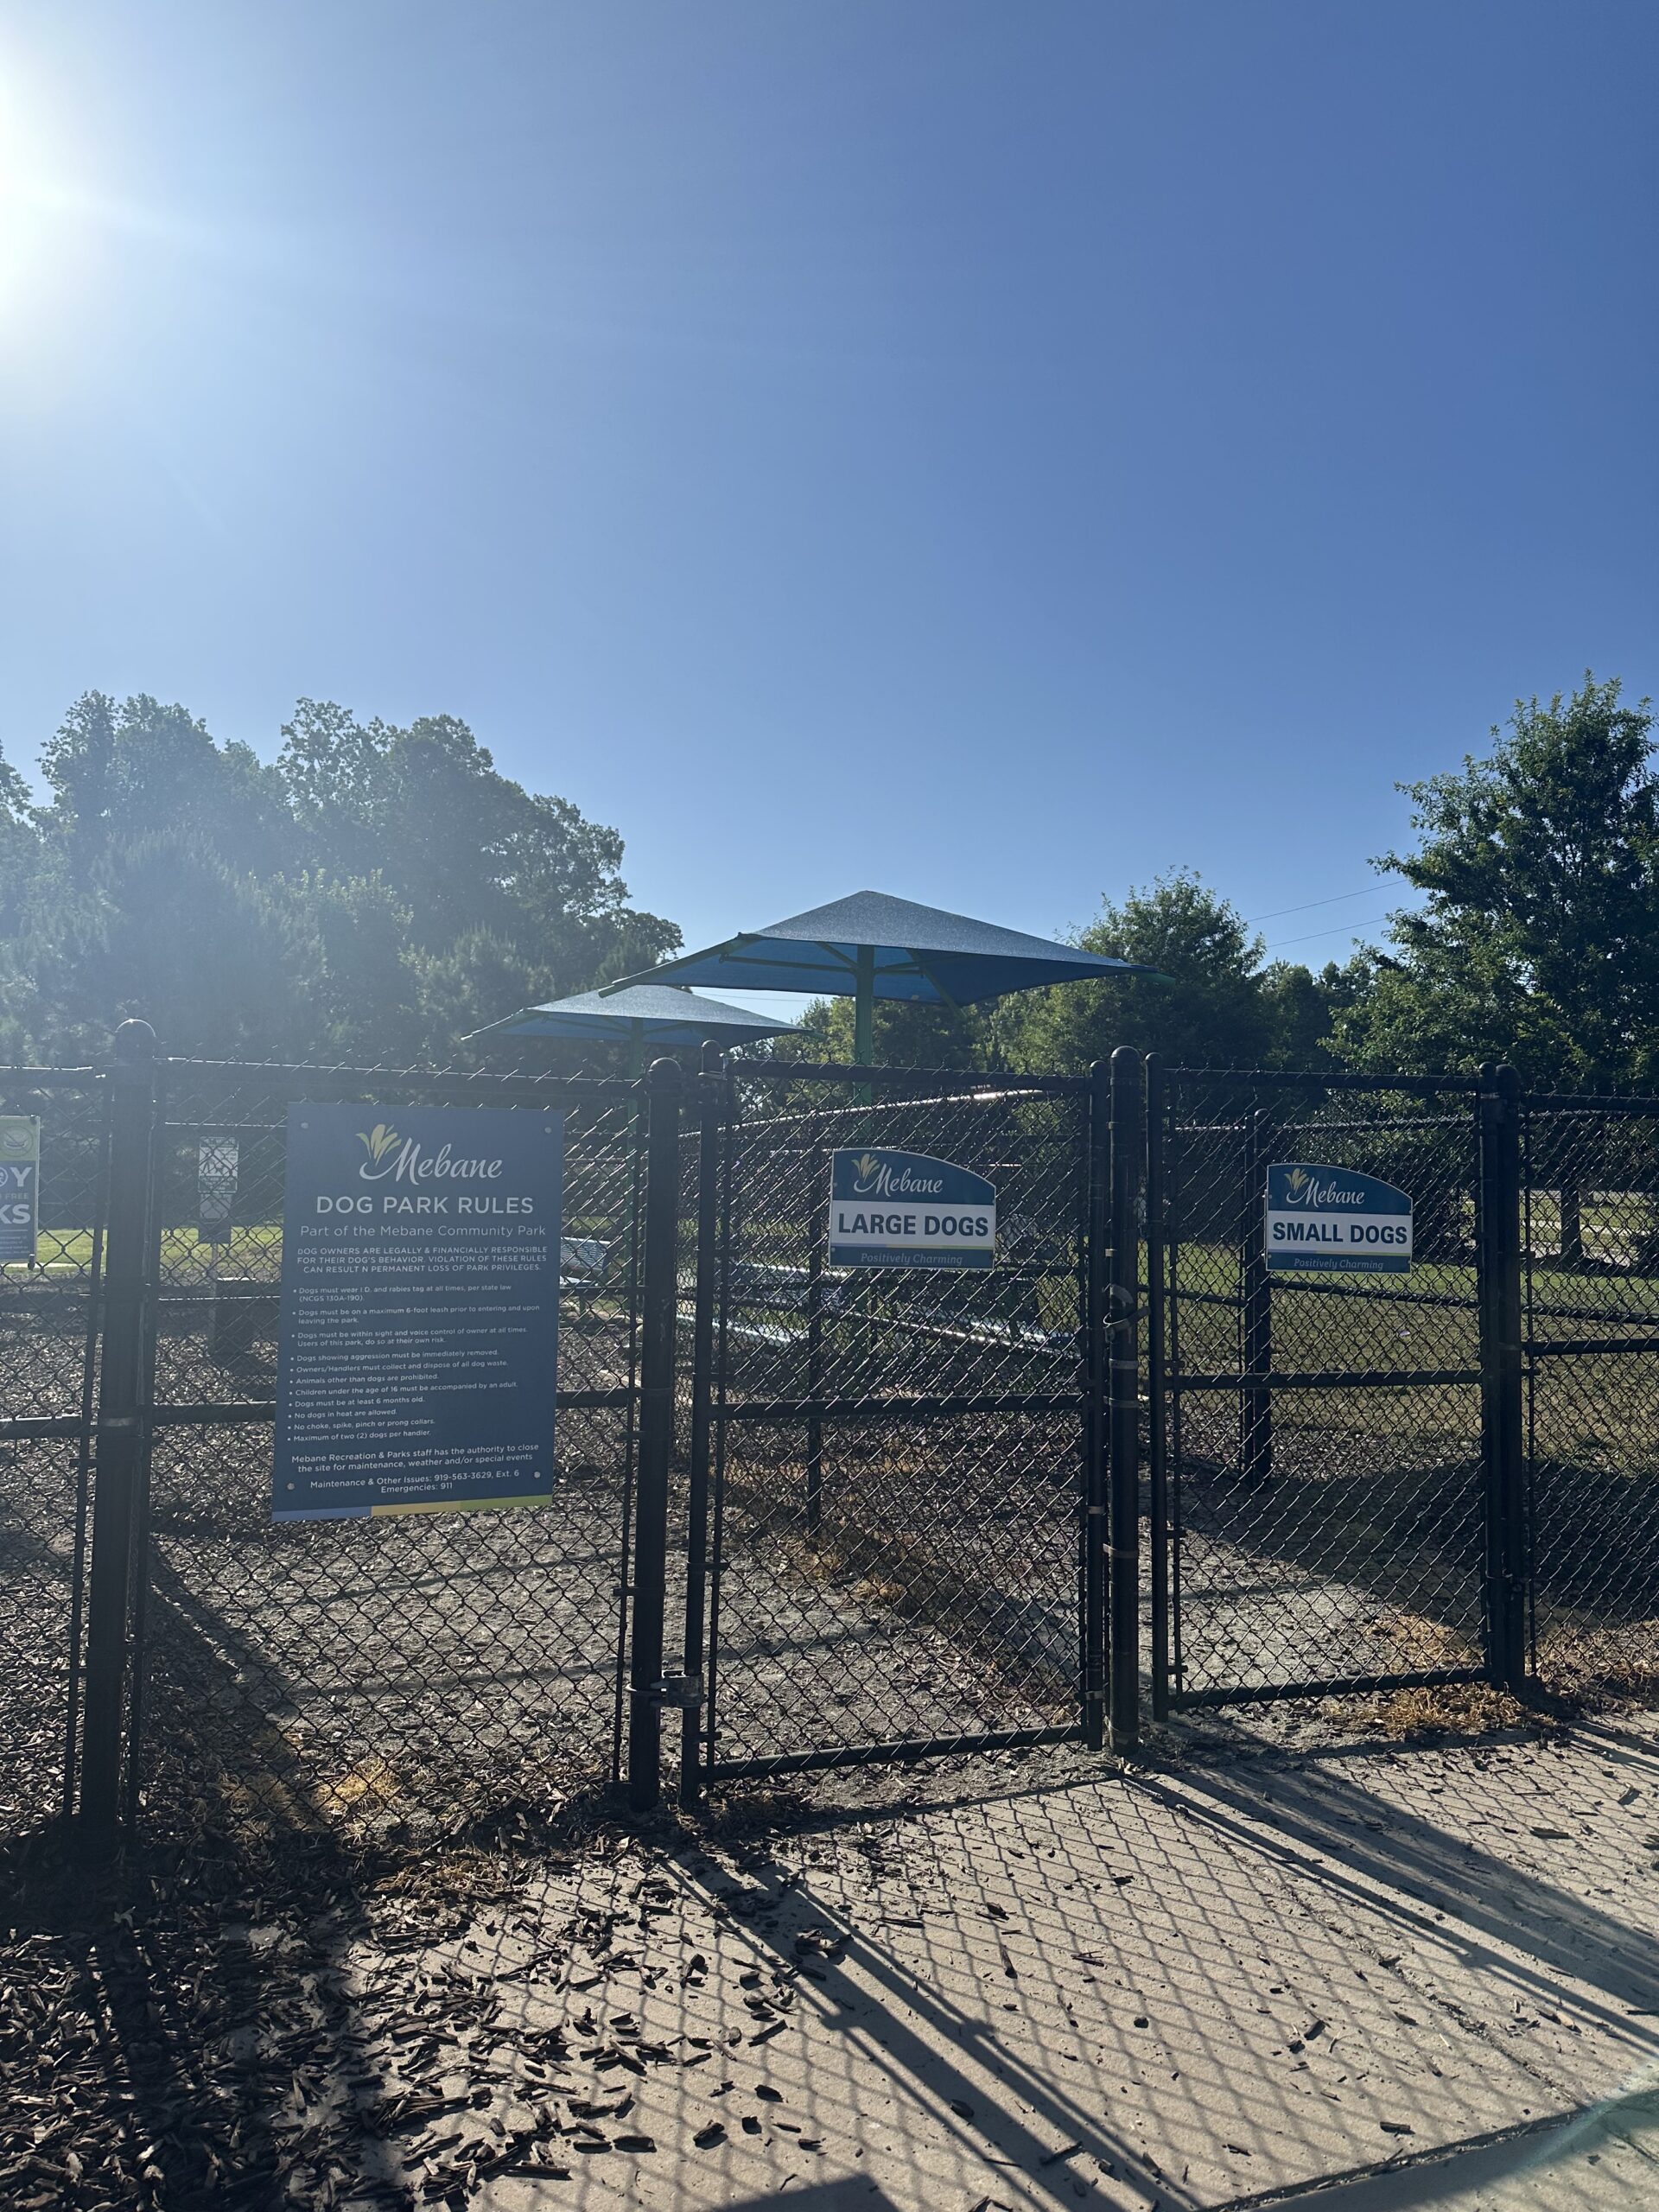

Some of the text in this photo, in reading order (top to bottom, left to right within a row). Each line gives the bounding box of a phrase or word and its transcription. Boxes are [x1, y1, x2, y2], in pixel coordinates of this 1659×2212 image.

[359, 1137, 503, 1185] Mebane
[853, 1163, 944, 1198] Mebane
[1286, 1177, 1365, 1208] Mebane
[316, 1196, 533, 1214] DOG PARK RULES
[301, 1224, 546, 1238] Part of the Mebane Community Park
[838, 1213, 988, 1236] LARGE DOGS
[1273, 1222, 1408, 1244] SMALL DOGS
[861, 1253, 963, 1266] Positively Charming
[1294, 1258, 1385, 1270] Positively Charming
[326, 1265, 359, 1274] RESULT
[296, 1364, 360, 1373] Owners/Handlers
[429, 1382, 477, 1391] accompanied
[478, 1382, 487, 1390] by
[355, 1421, 376, 1429] pinch
[291, 1454, 327, 1463] Mebane
[328, 1452, 376, 1461] Recreation
[378, 1451, 385, 1459] &
[387, 1450, 410, 1459] Parks
[412, 1448, 432, 1457] staff
[467, 1446, 505, 1455] authority
[297, 1465, 313, 1473] the
[333, 1463, 346, 1471] for
[408, 1458, 442, 1467] weather
[444, 1455, 474, 1465] and/or
[475, 1454, 505, 1464] special
[505, 1452, 533, 1461] events
[310, 1479, 365, 1489] Maintenance
[376, 1477, 402, 1485] Other
